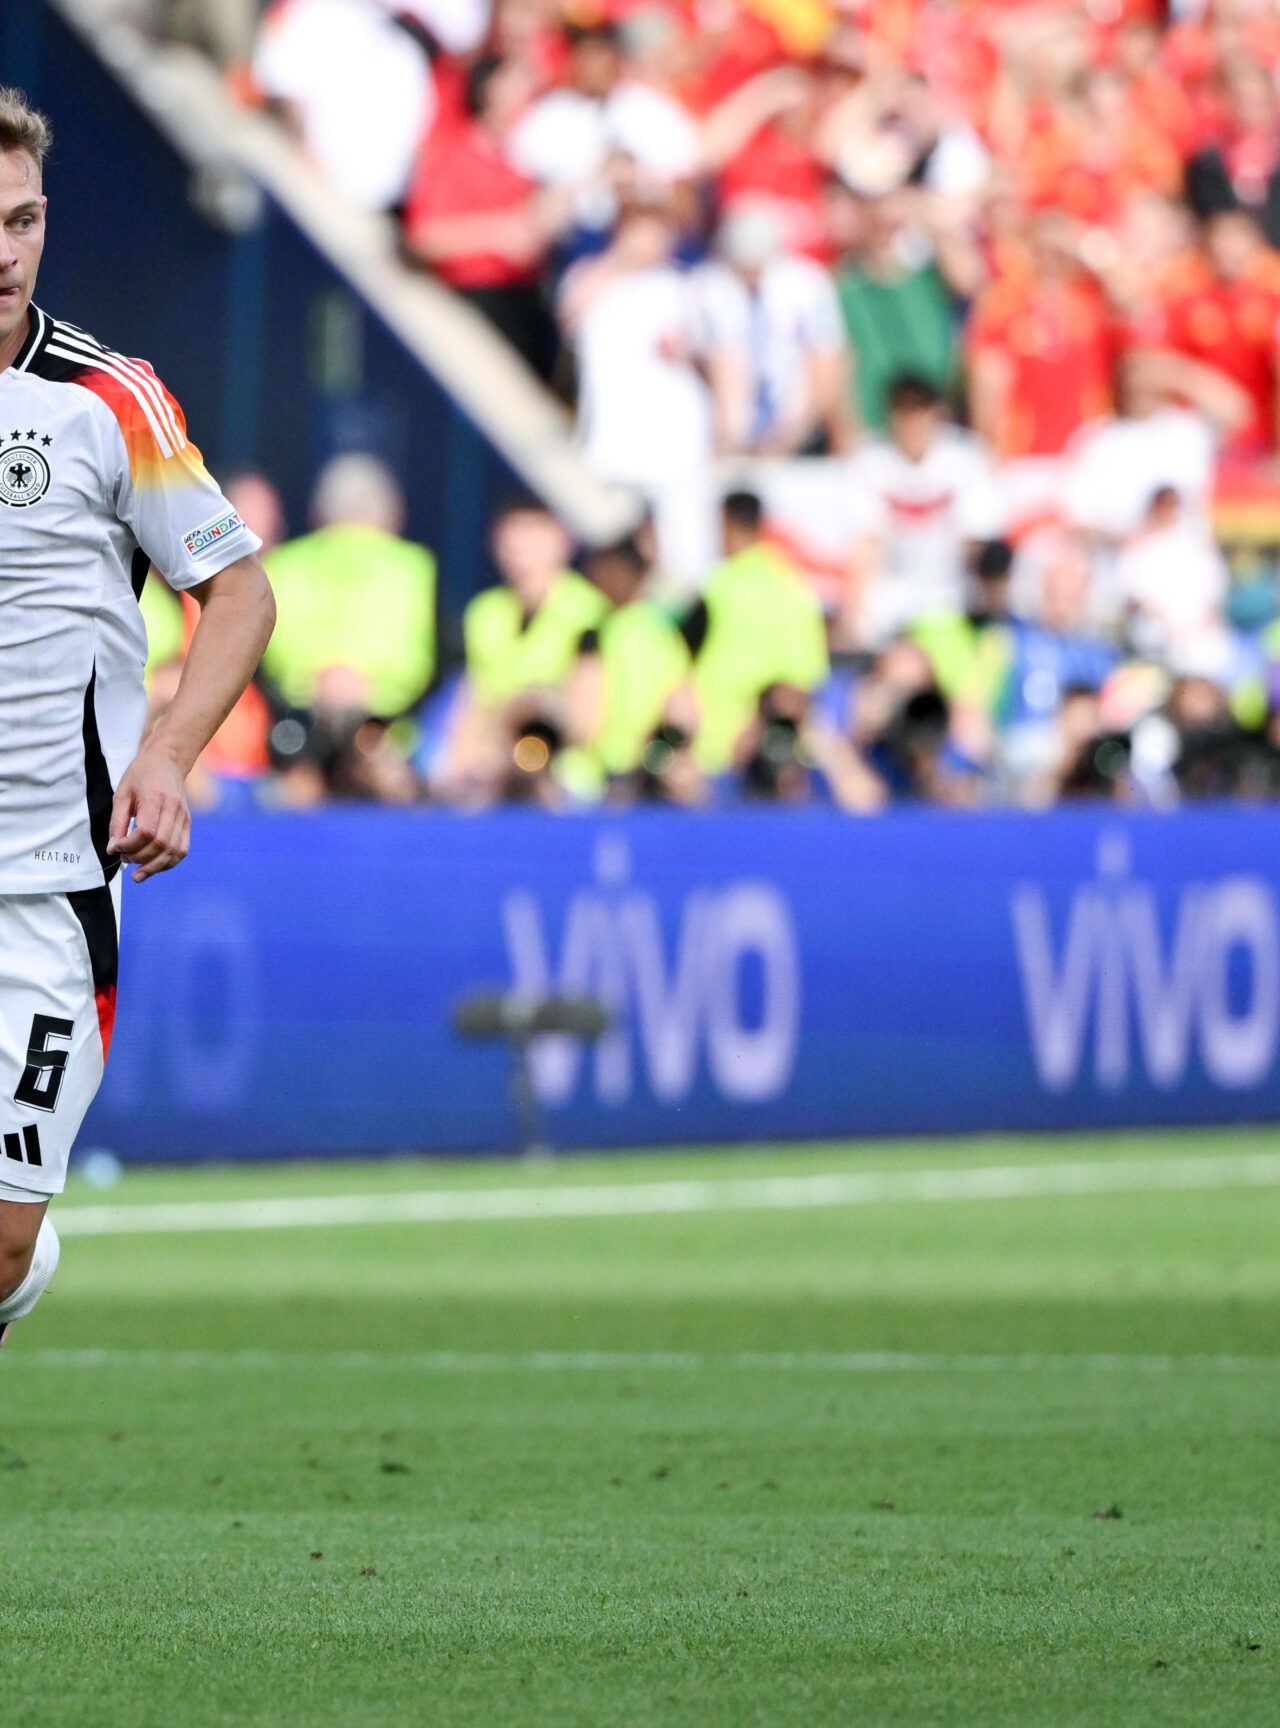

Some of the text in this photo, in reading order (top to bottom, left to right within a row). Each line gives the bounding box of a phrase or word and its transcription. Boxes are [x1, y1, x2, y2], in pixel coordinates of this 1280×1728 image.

[3, 452, 37, 465] DEUTSCHER
[183, 530, 201, 544] UEFA
[14, 1013, 74, 1113] 6
